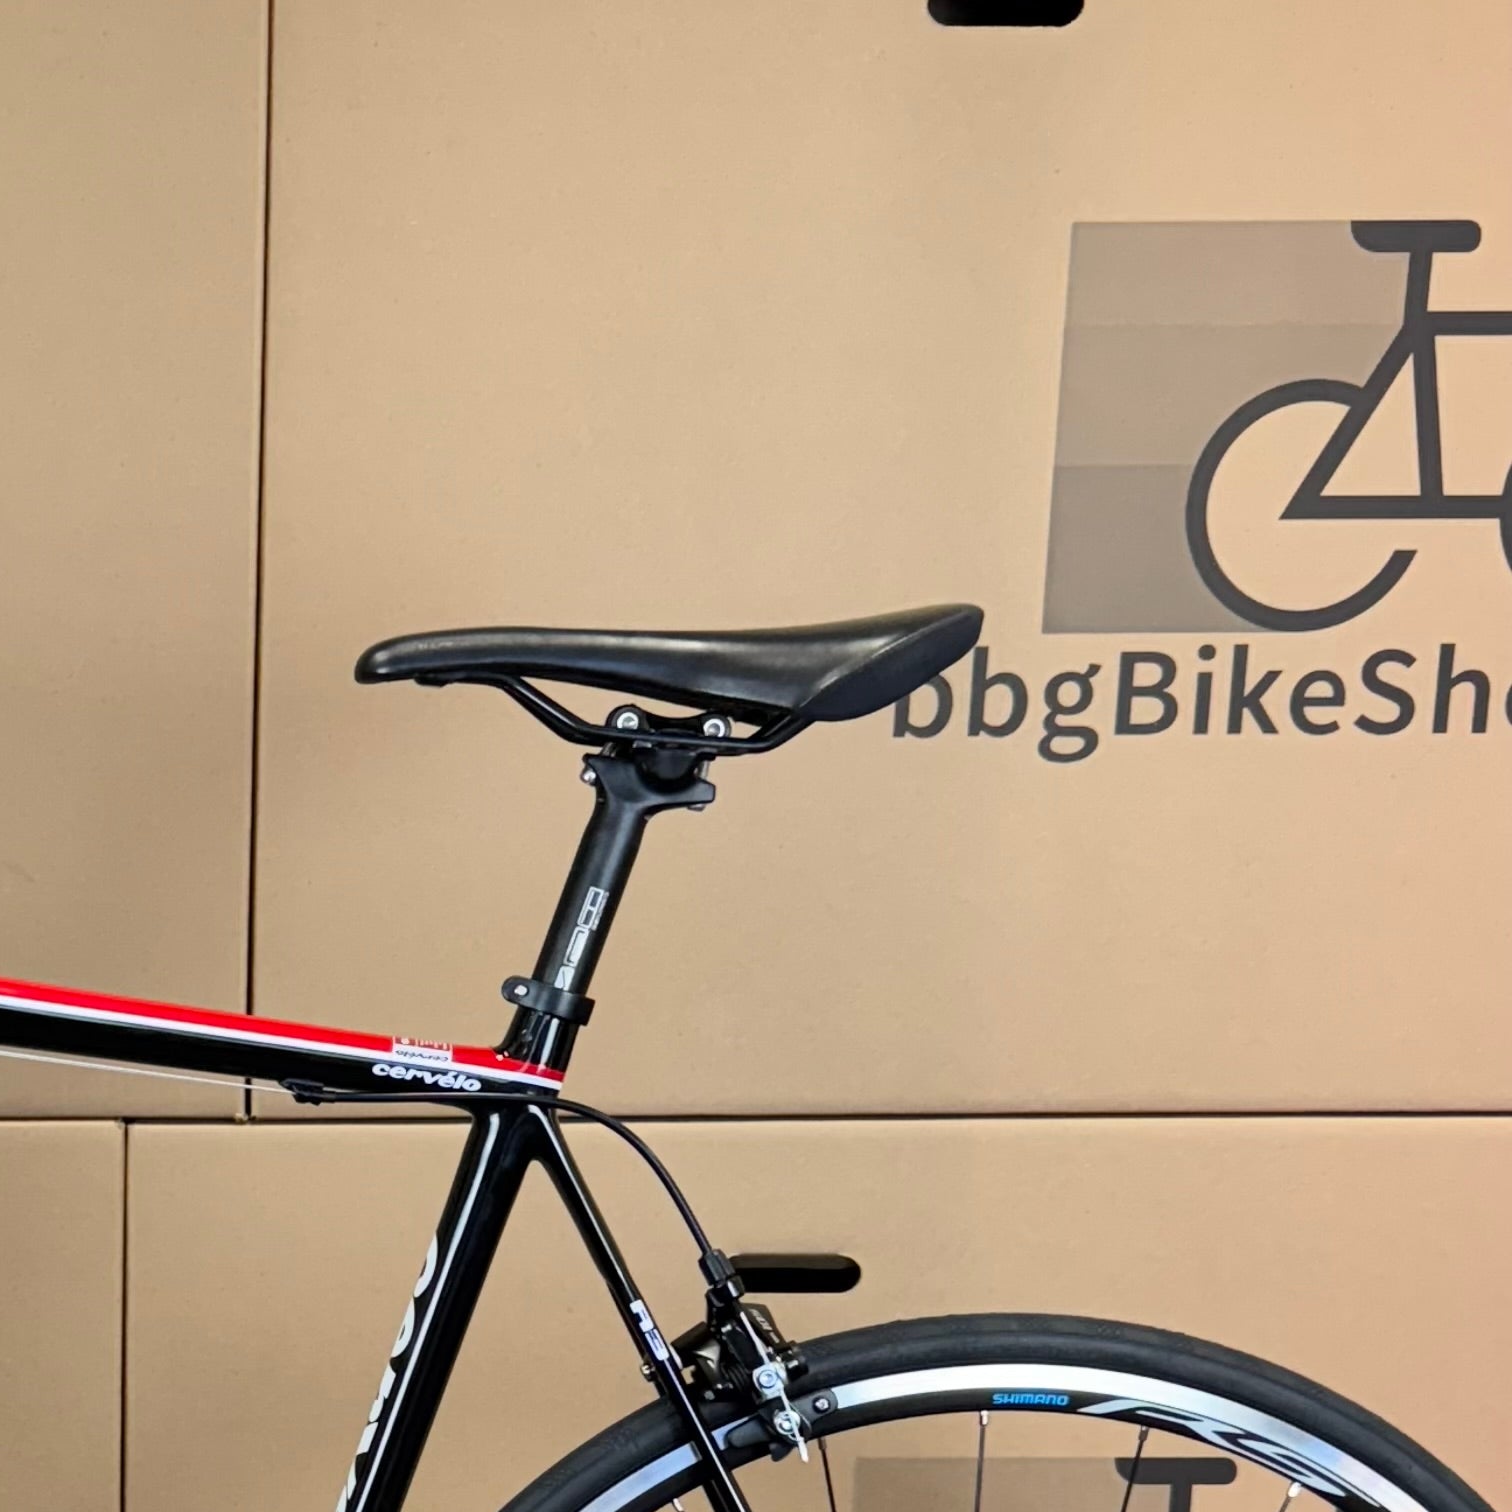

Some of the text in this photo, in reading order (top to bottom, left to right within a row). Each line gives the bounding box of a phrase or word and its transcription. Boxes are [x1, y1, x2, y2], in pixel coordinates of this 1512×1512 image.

[892, 643, 1512, 763] bbgBikeSh
[371, 1062, 482, 1093] cervélo
[629, 1299, 670, 1361] R3
[991, 1391, 1070, 1407] SHIMANO
